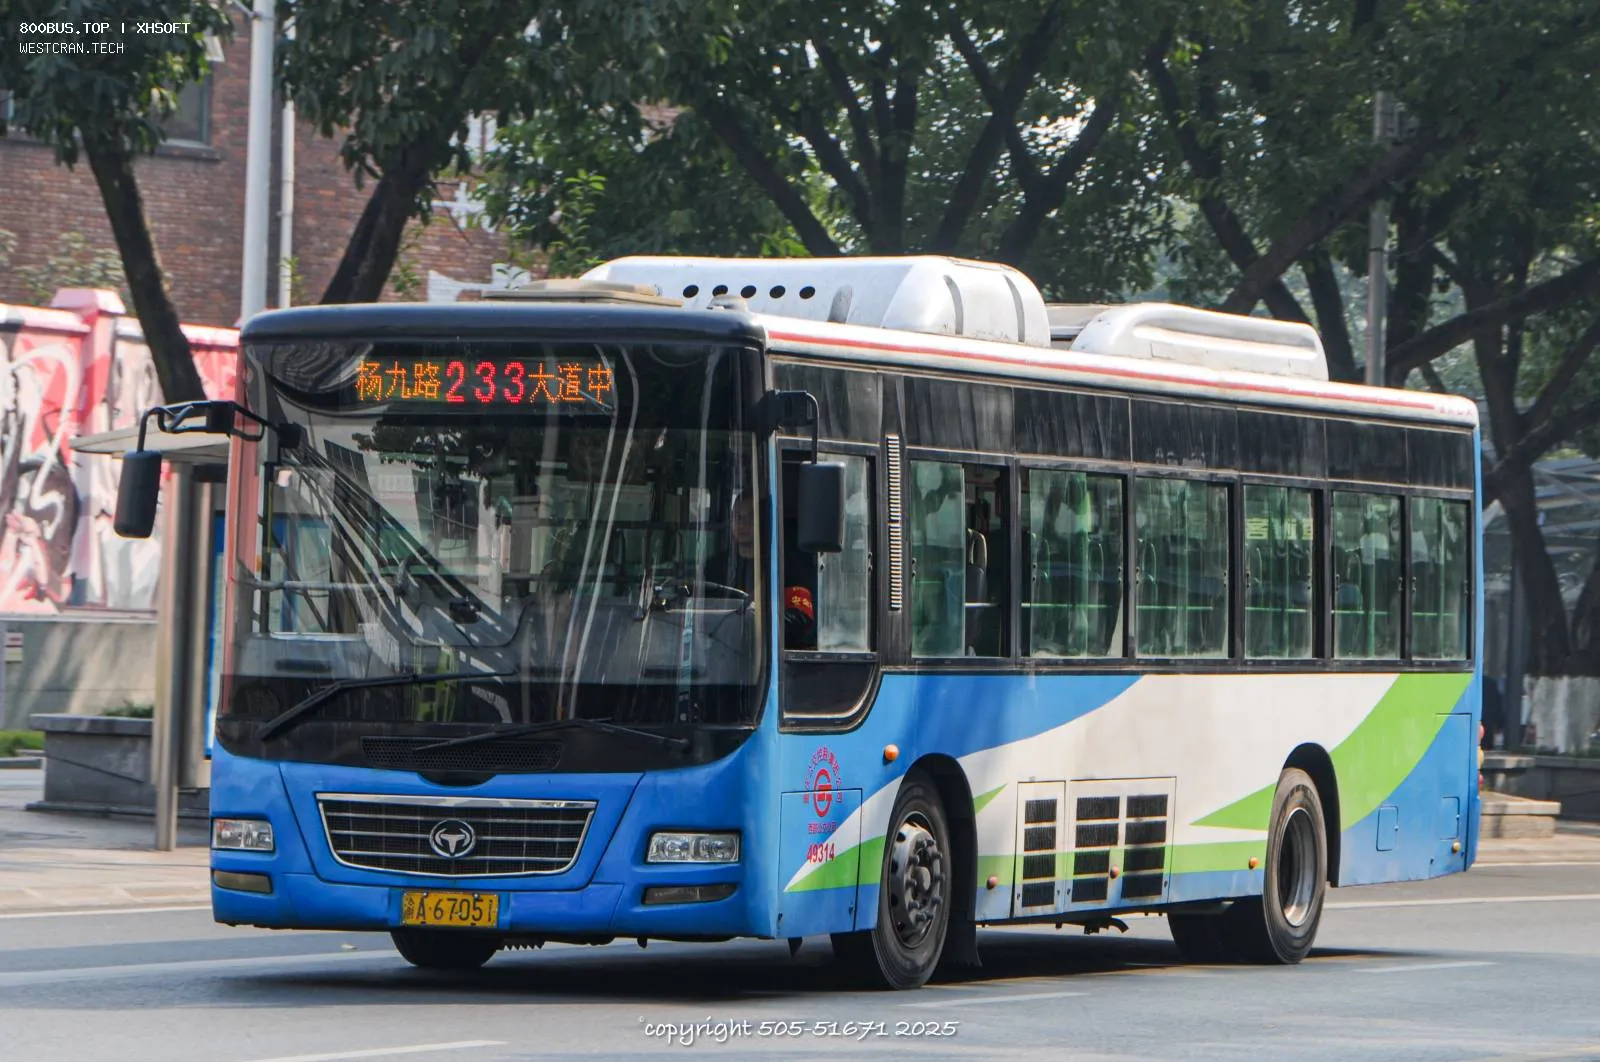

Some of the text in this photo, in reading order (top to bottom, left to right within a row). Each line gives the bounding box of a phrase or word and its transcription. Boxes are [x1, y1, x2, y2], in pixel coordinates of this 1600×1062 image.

[355, 361, 613, 404] 杨九路 233 大道中
[807, 842, 835, 863] 49314
